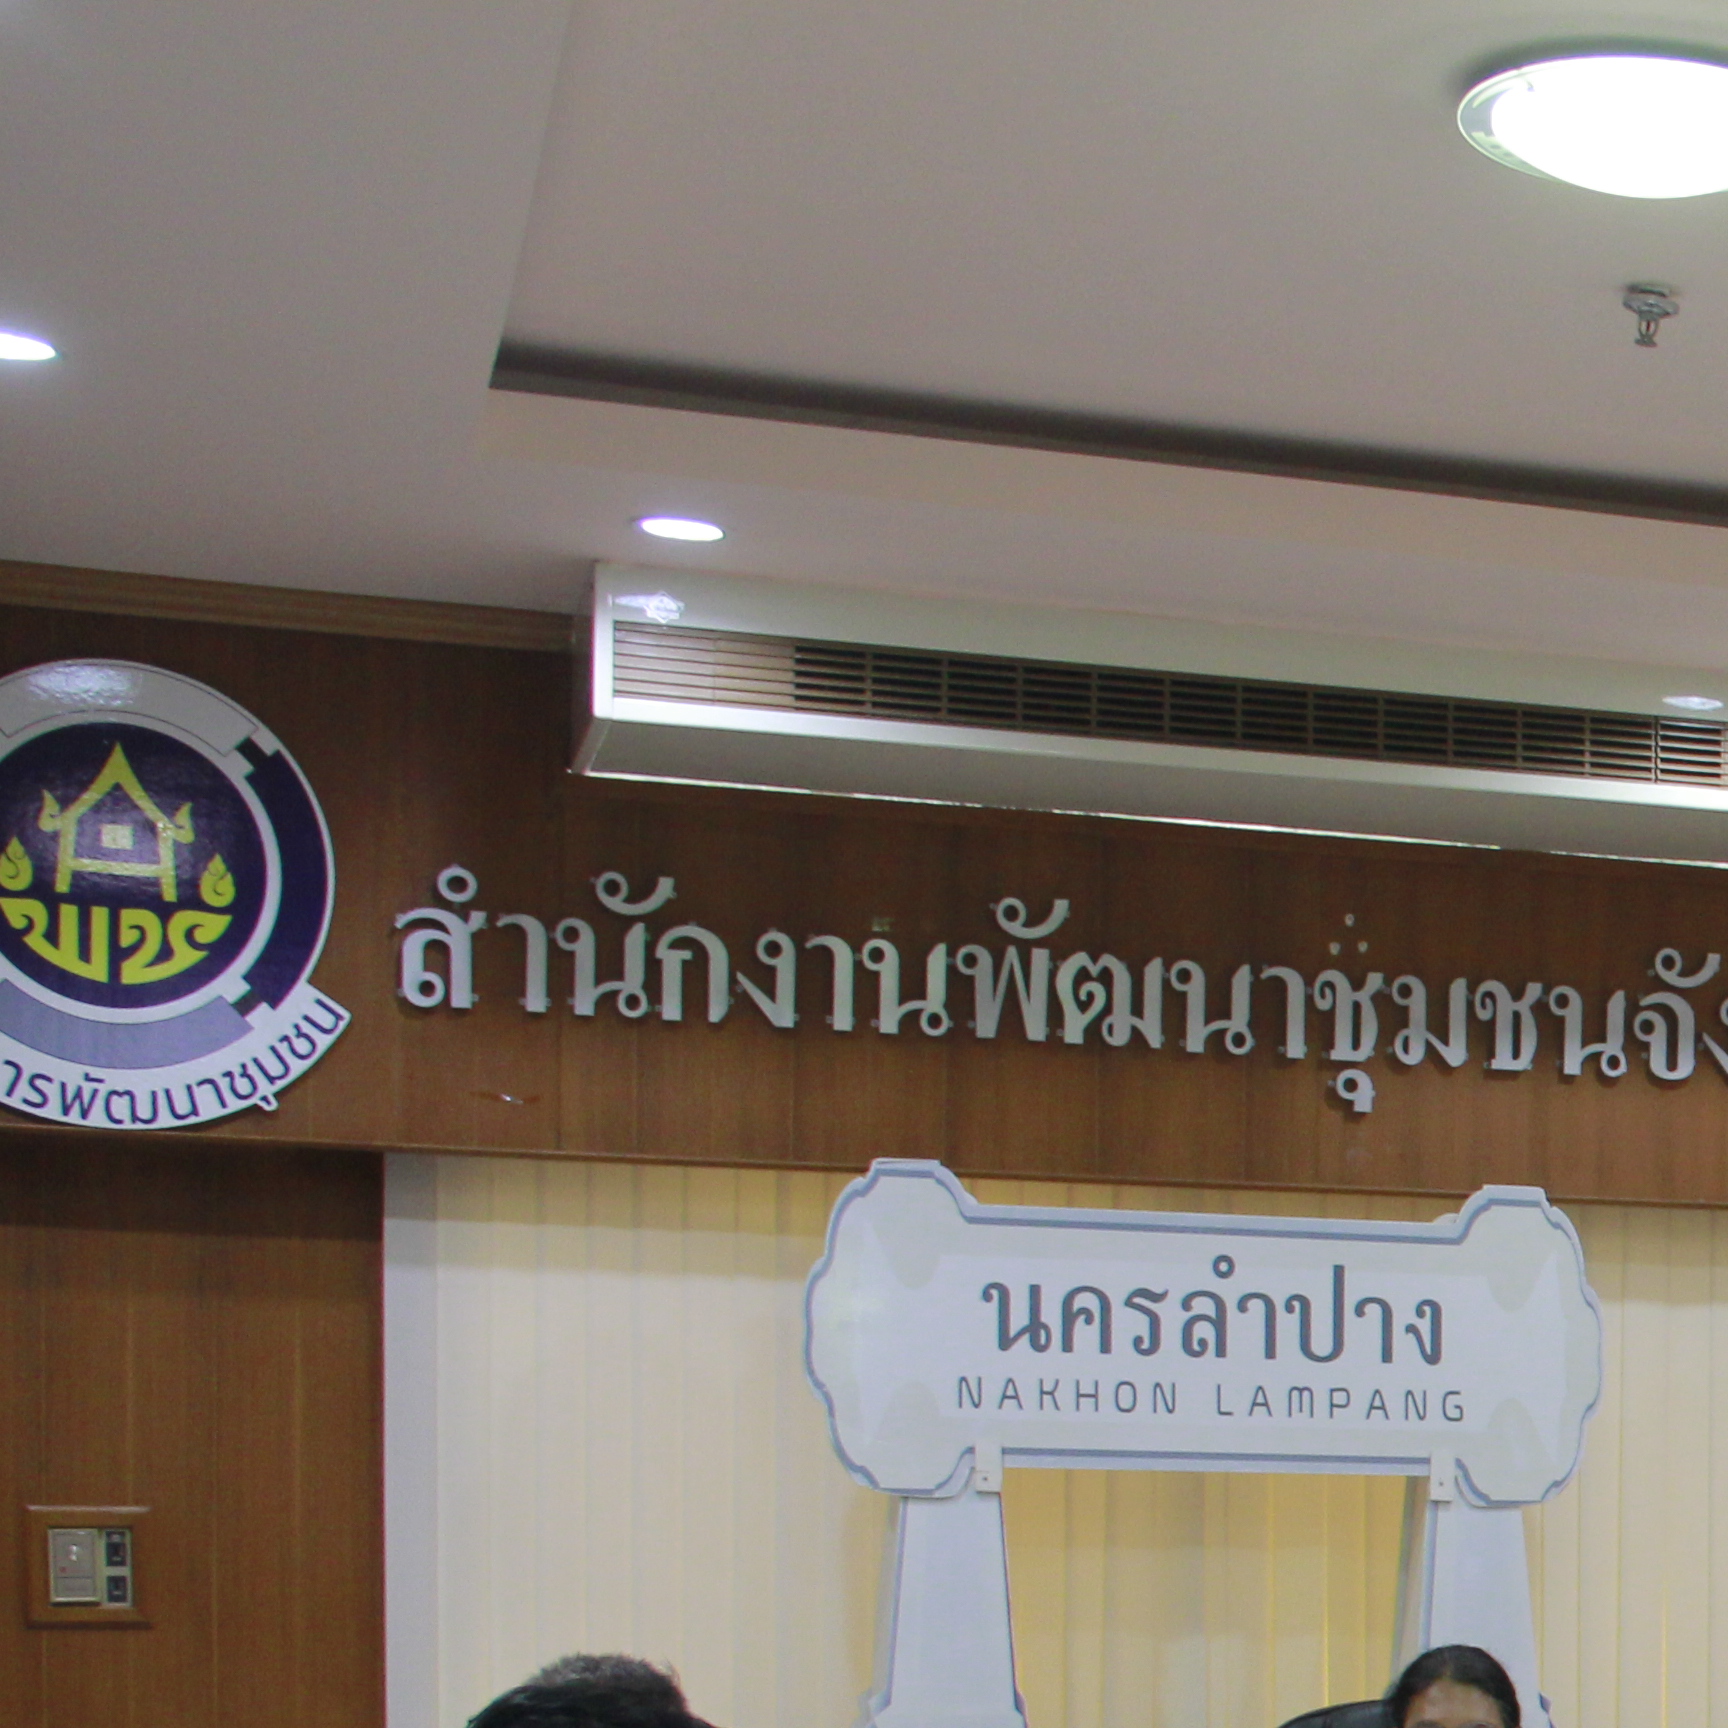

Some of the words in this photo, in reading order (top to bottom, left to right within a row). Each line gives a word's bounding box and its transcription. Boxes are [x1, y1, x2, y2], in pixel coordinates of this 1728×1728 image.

[981, 1254, 1444, 1366] นครลำปาง
[957, 1375, 1177, 1415] NAKHON
[1216, 1383, 1466, 1423] LAMPANG
